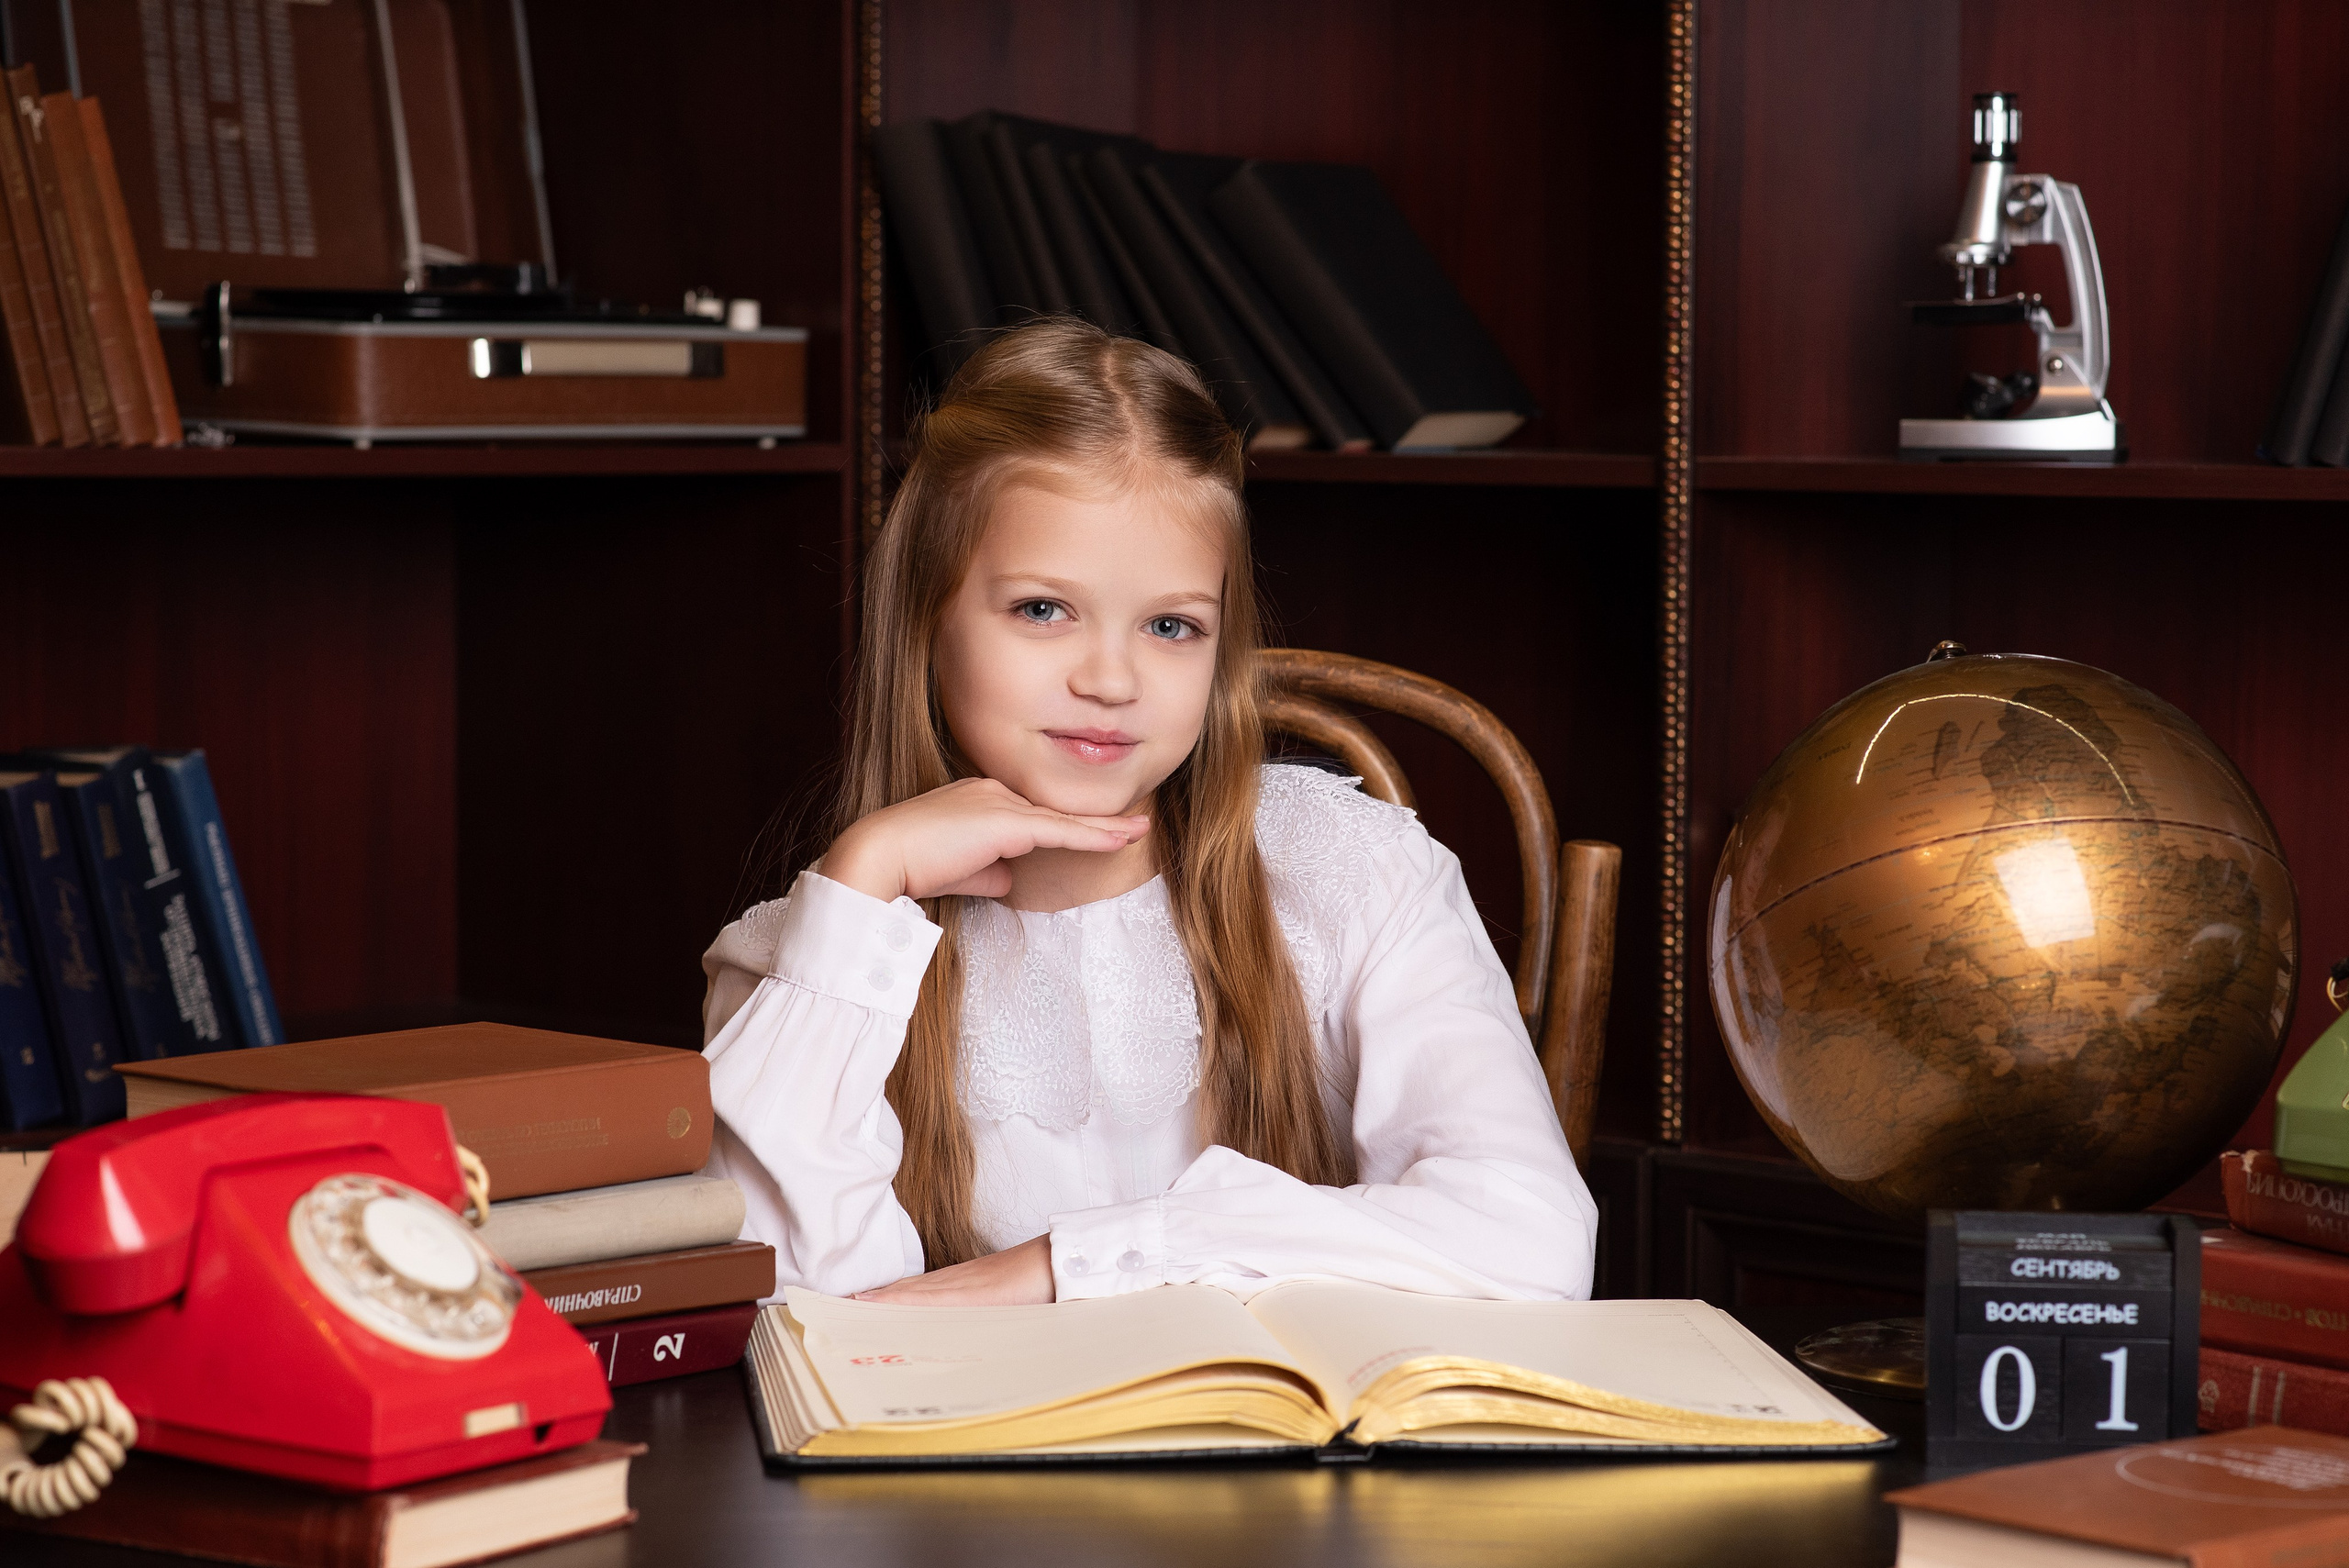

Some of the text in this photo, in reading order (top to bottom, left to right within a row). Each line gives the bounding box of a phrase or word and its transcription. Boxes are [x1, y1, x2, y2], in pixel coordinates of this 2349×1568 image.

[2010, 1258, 2120, 1281] СЕНТЯБРЬ
[1985, 1301, 2139, 1325] ВОСКРЕСЕНЬЕ
[653, 1333, 685, 1362] 2
